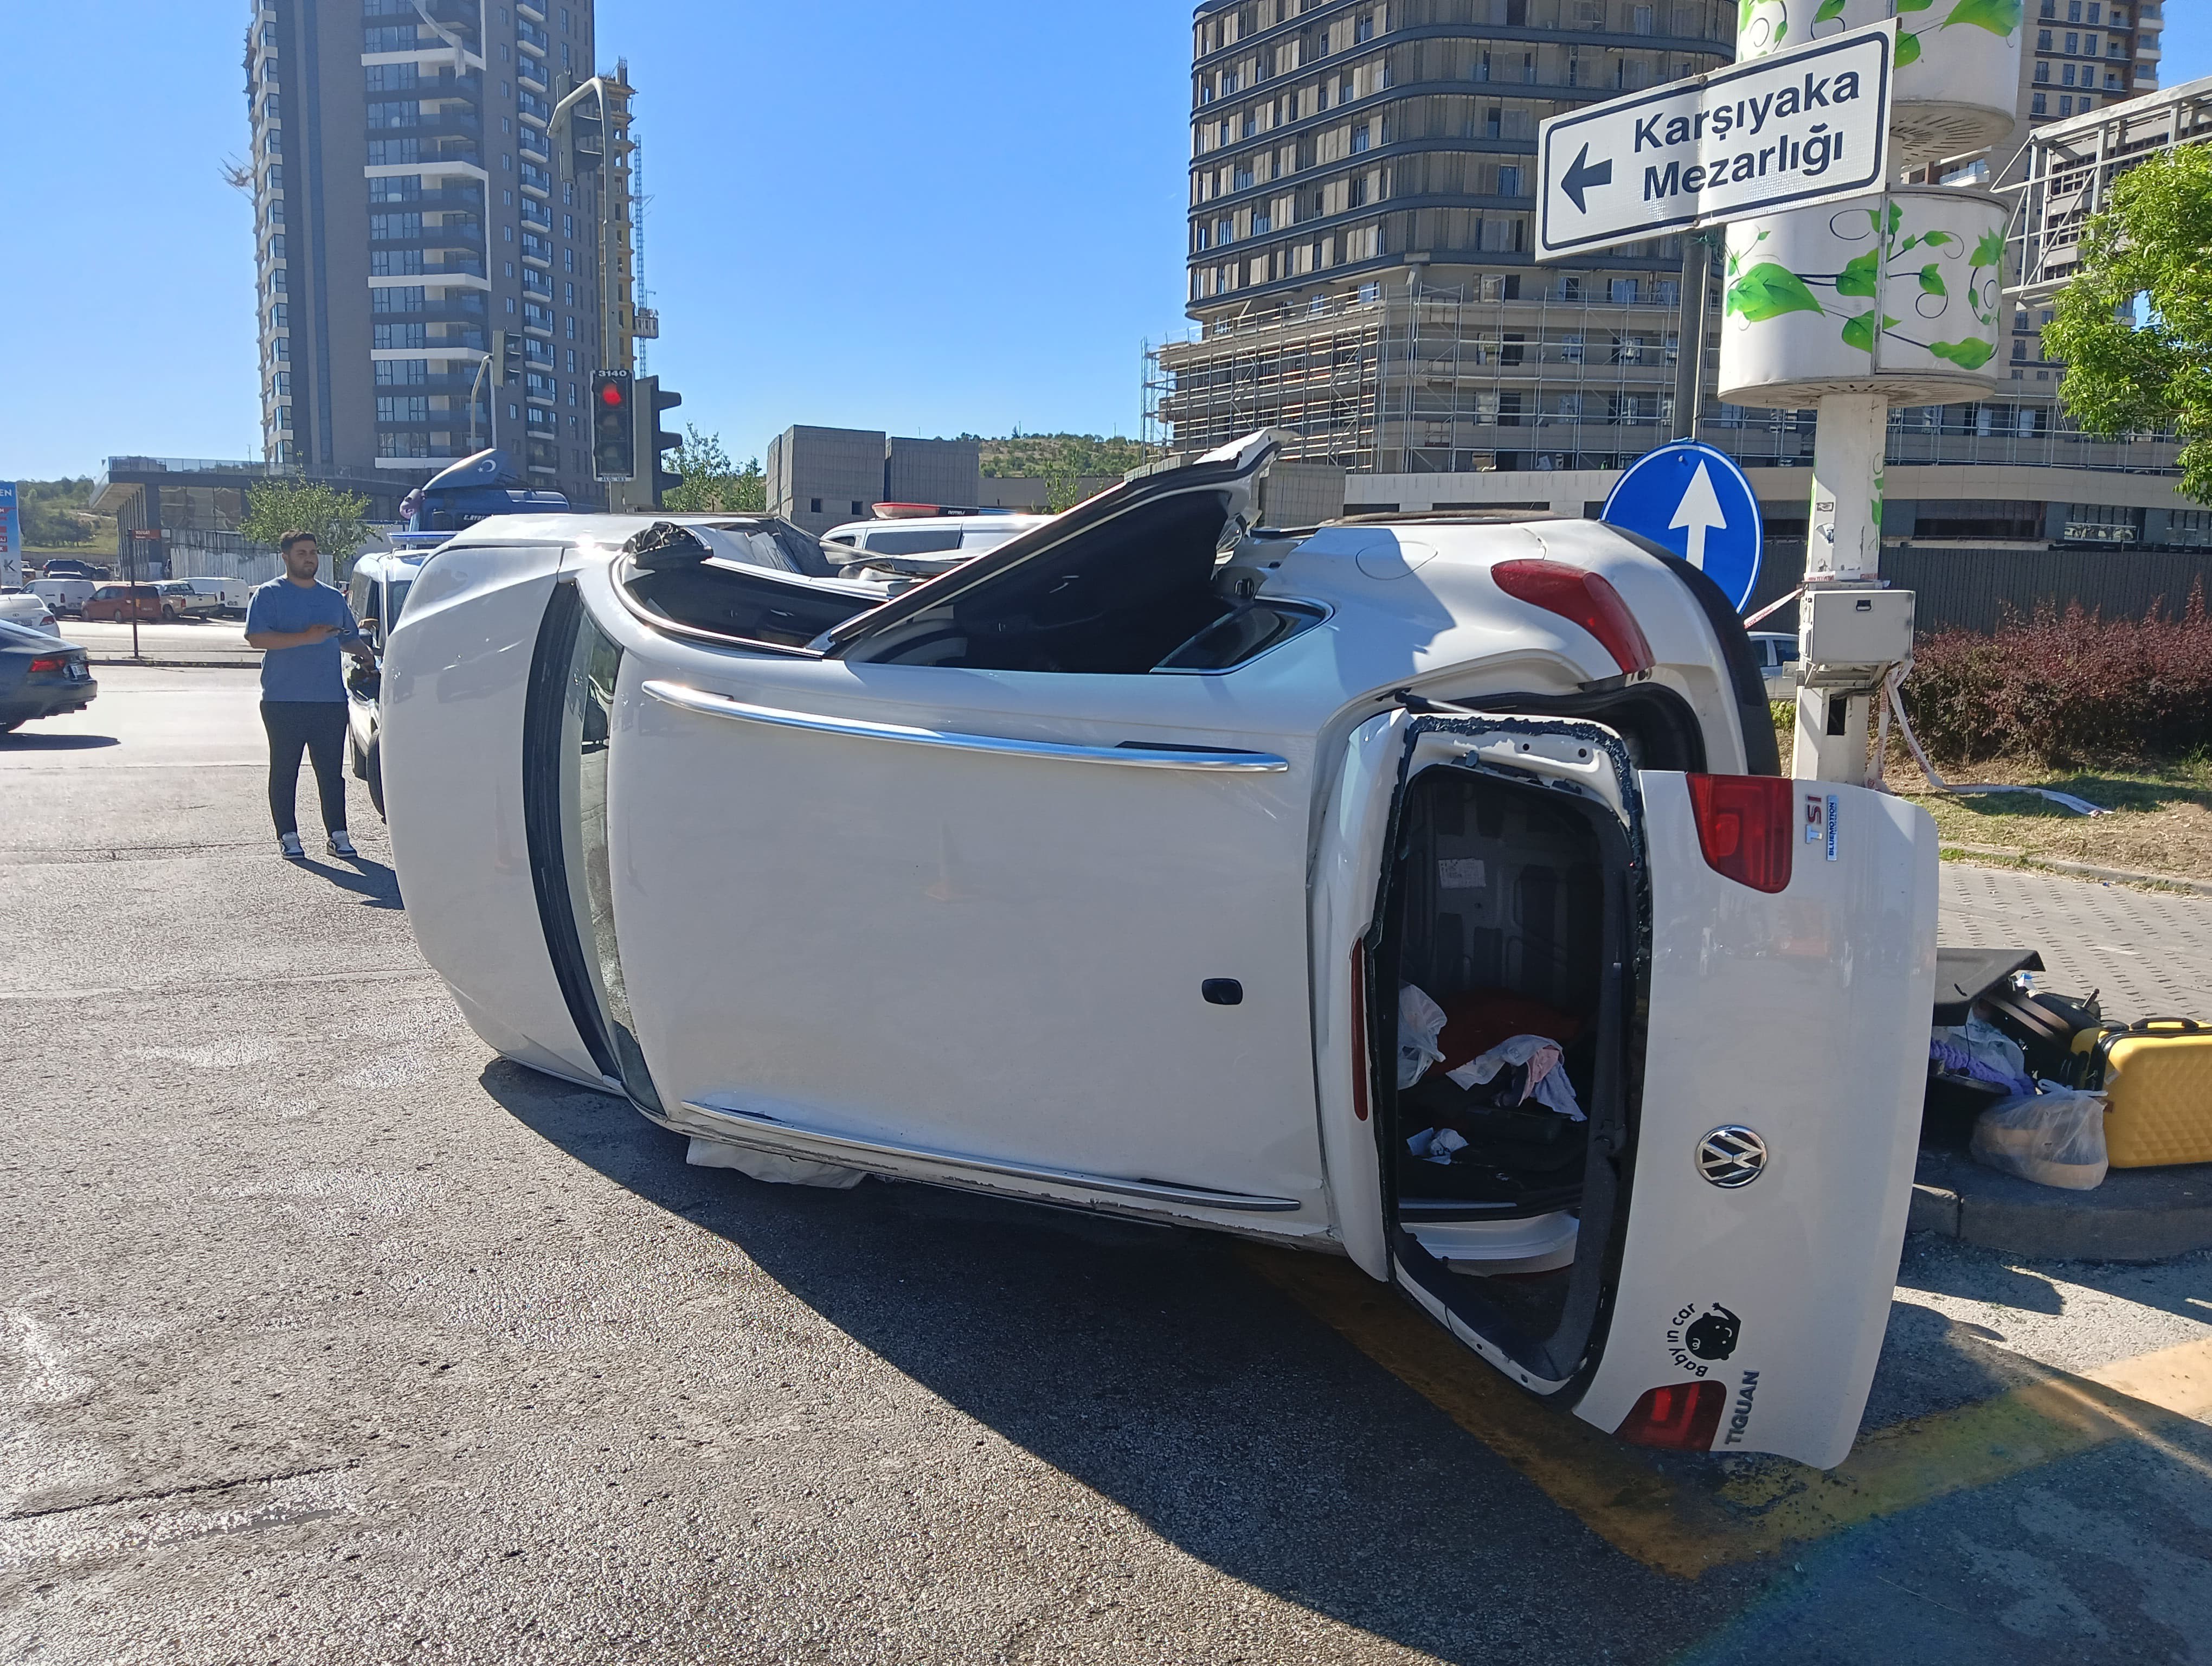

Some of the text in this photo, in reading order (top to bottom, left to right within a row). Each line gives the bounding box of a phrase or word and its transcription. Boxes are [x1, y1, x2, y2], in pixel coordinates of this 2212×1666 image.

[1634, 71, 1859, 153] Karşıyaka
[1643, 123, 1843, 202] Mezarlığı
[1805, 794, 1823, 844] TSI
[1667, 1303, 1708, 1377] Baby in car
[1724, 1369, 1760, 1445] TIGUAN
